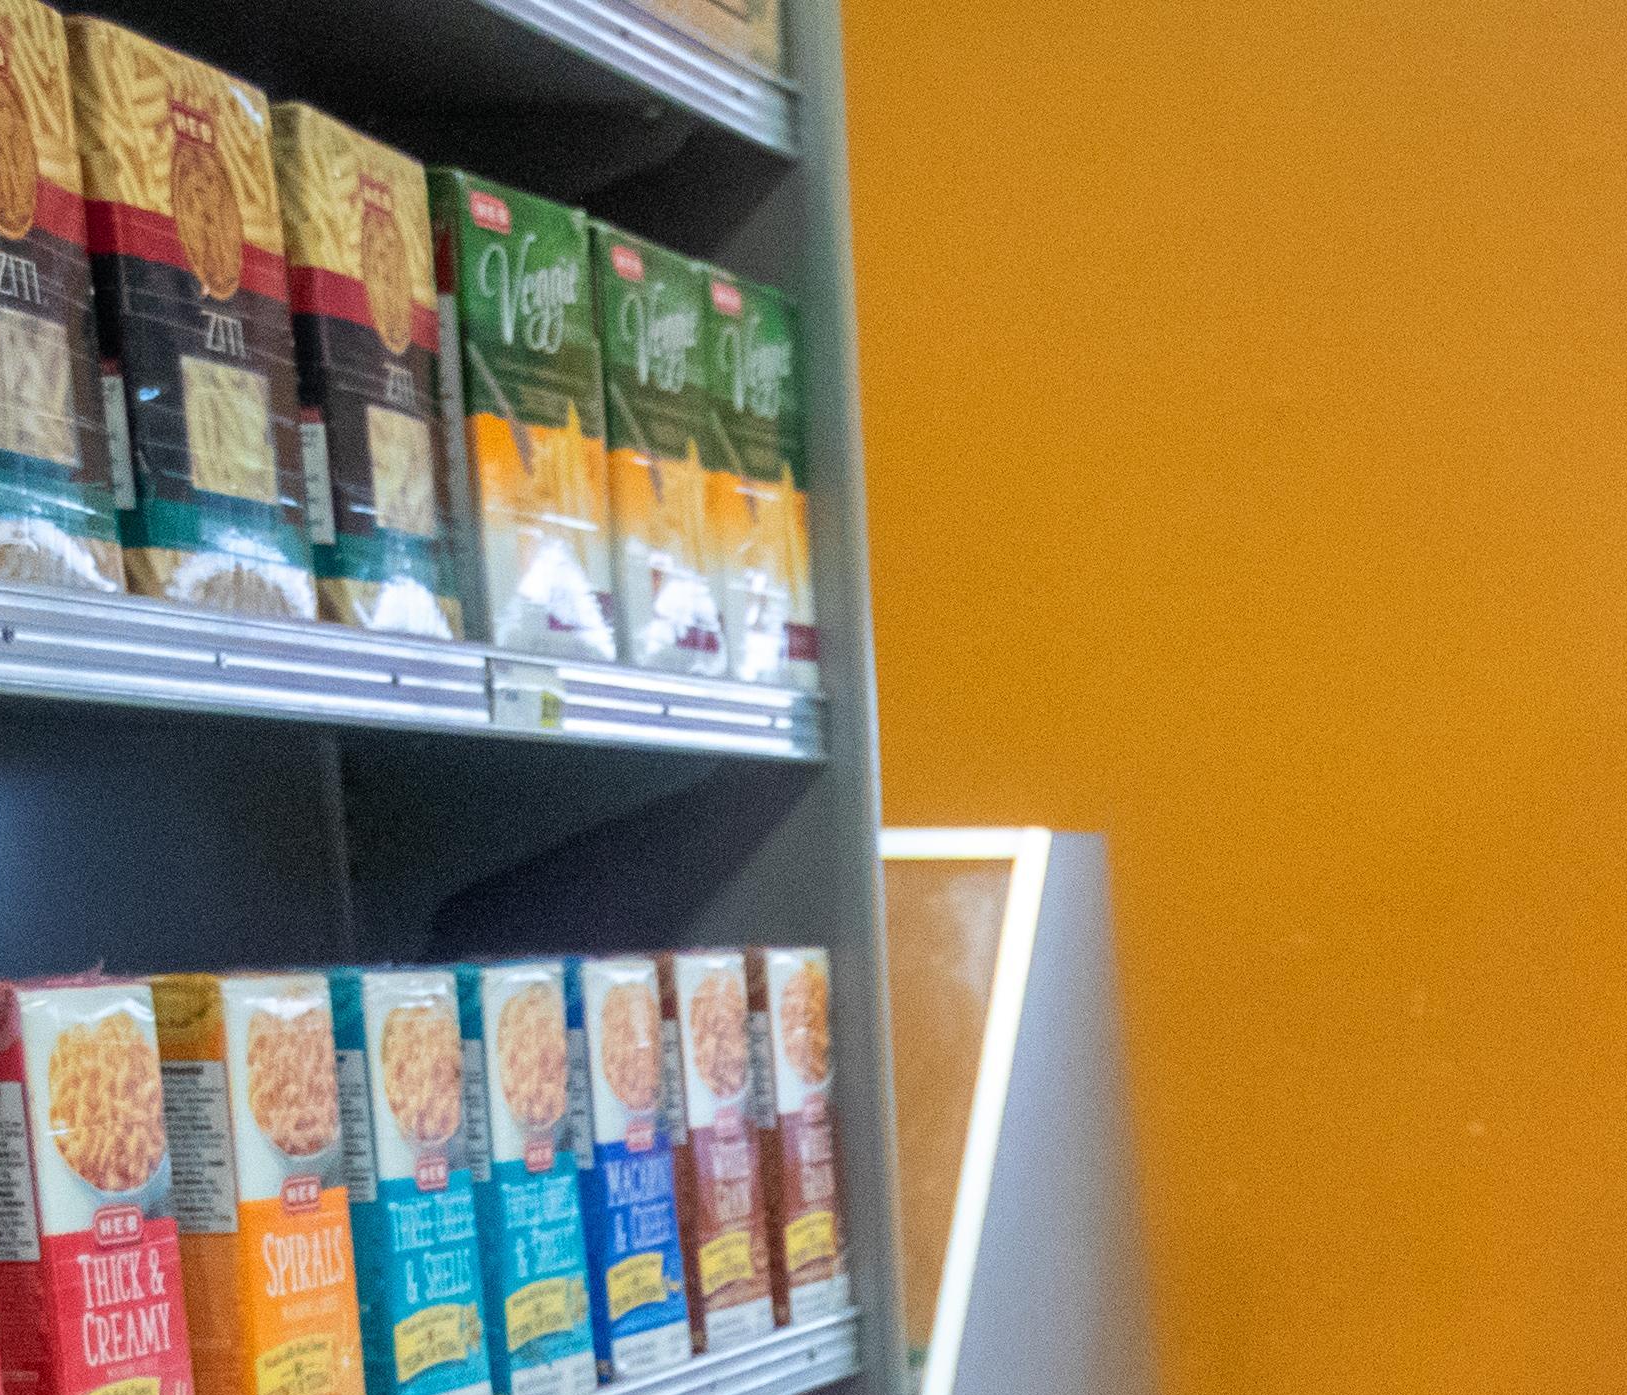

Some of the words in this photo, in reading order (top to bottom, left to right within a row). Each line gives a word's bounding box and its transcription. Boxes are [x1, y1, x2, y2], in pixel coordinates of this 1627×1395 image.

[76, 1250, 144, 1310] THICK
[262, 1225, 347, 1299] SPIRALS
[82, 1303, 172, 1368] CREAMY
